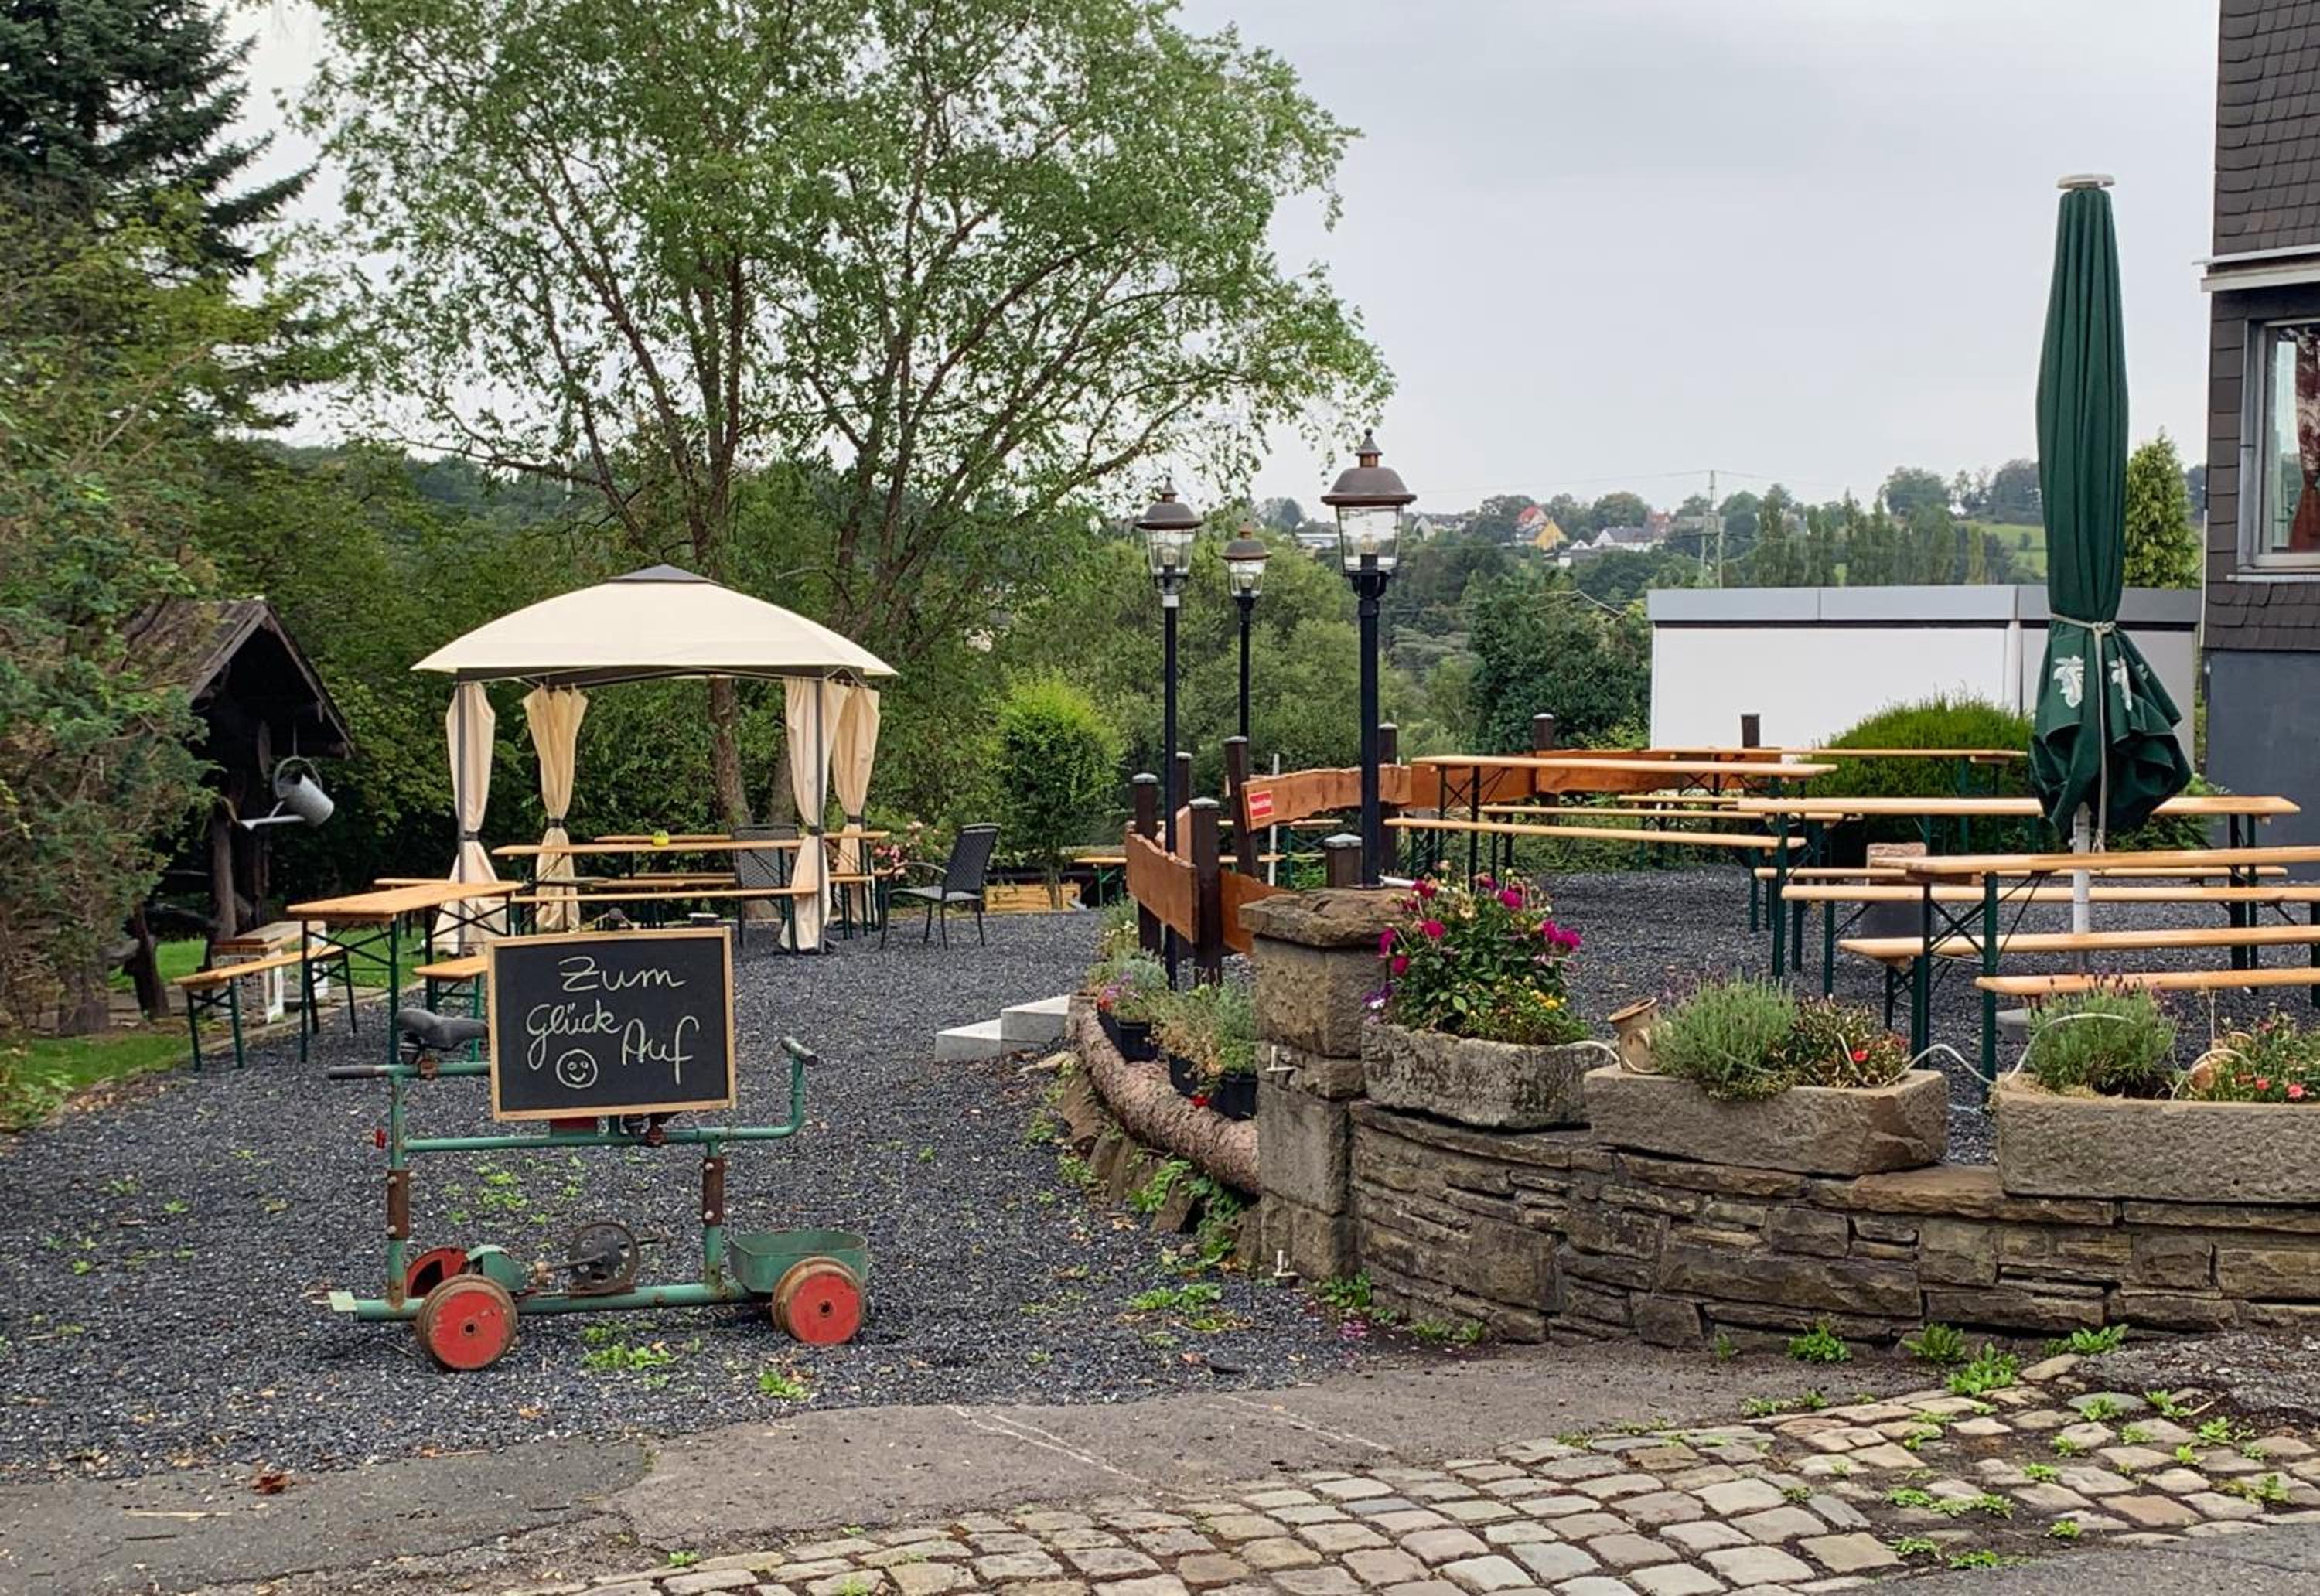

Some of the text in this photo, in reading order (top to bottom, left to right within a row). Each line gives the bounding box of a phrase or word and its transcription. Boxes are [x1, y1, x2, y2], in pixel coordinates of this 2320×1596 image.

[558, 956, 687, 992] Zum
[526, 998, 700, 1085] Glück Auf
